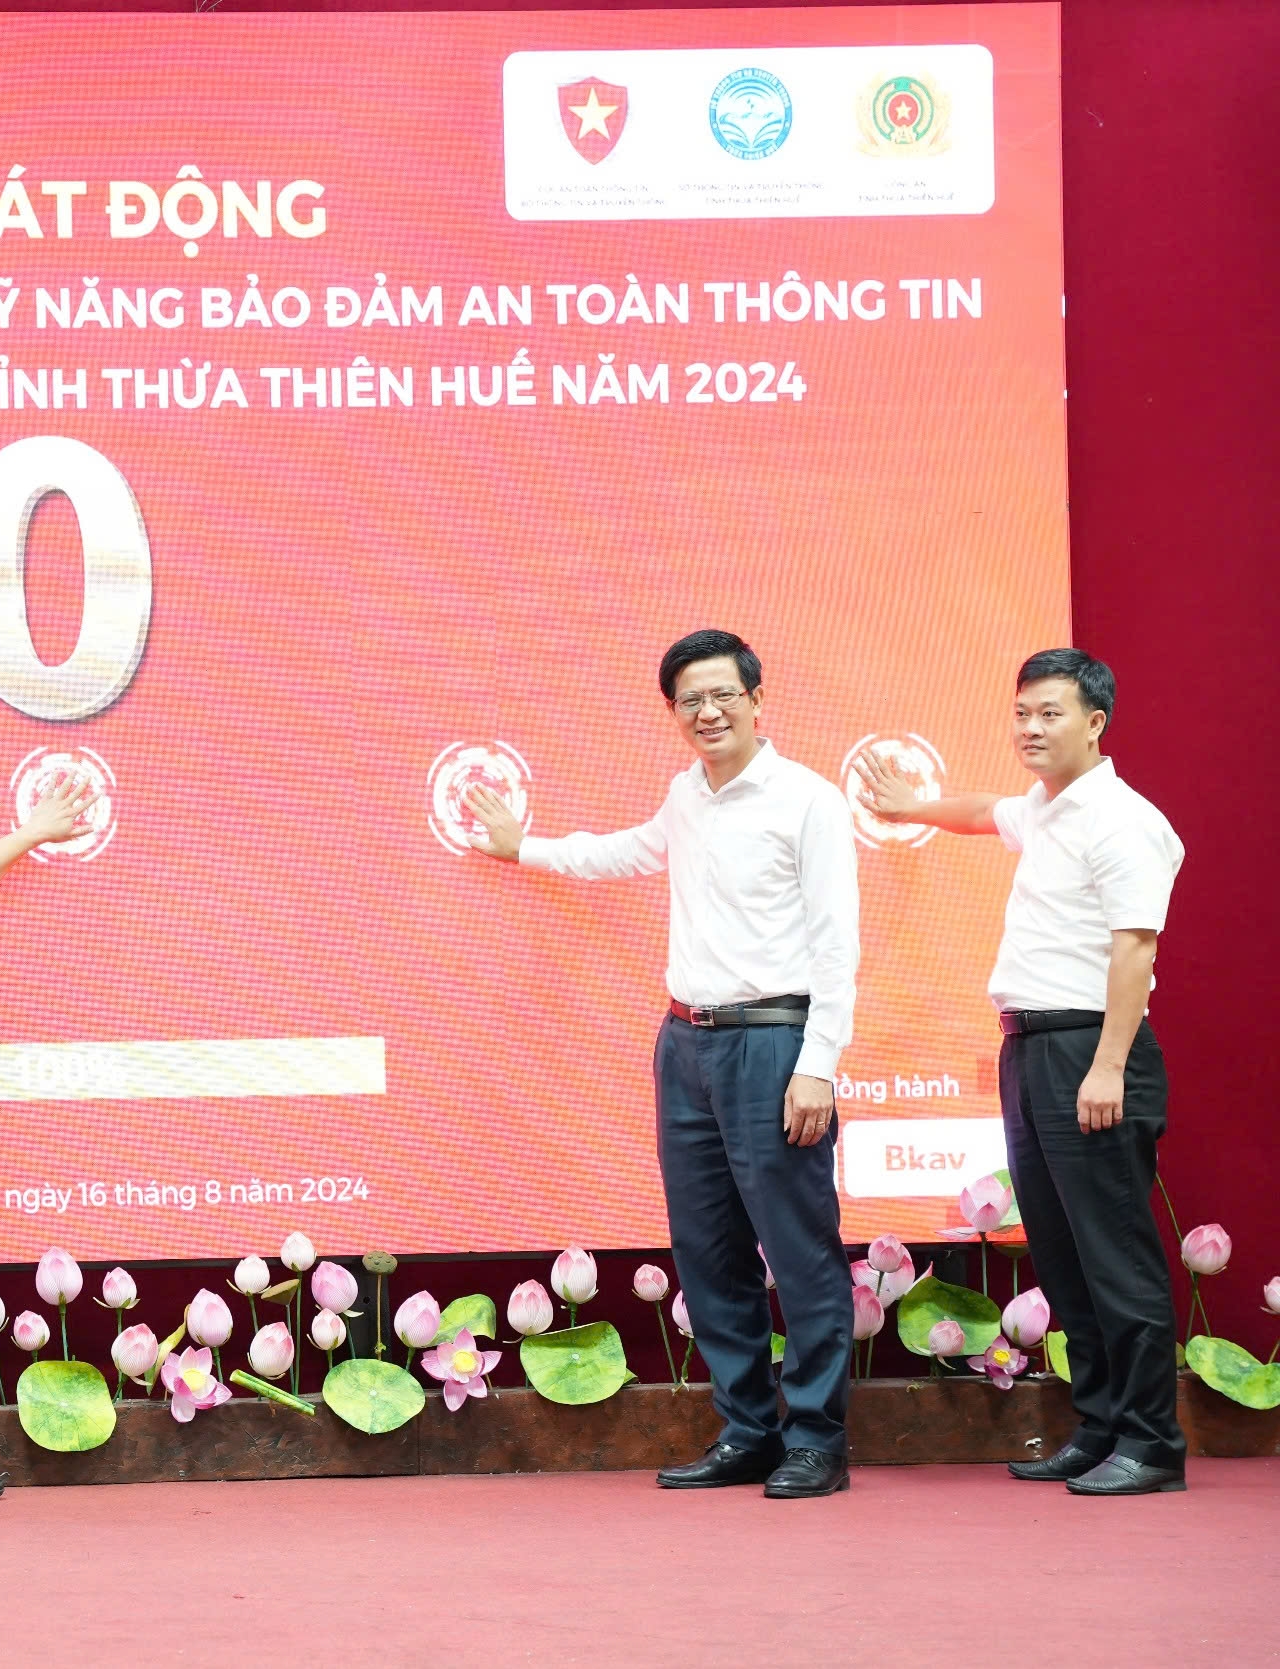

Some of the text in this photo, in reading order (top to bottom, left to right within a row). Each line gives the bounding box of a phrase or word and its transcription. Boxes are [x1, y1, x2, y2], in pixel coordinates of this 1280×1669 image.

[105, 164, 327, 258] ĐỘNG
[35, 276, 185, 329] NĂNG
[201, 273, 311, 329] BẢO
[323, 272, 443, 328] ĐẢM
[458, 284, 532, 327] AN
[546, 272, 690, 325] TOÀN
[703, 270, 886, 323] THÔNG
[898, 277, 982, 320] TIN
[101, 357, 249, 409] THỪA
[259, 355, 414, 408] THIÊN
[430, 349, 537, 407] HUẾ
[552, 352, 670, 405] NĂM
[684, 361, 808, 404] 2024
[895, 1073, 960, 1098] hành
[884, 1145, 966, 1171] Bkav
[4, 1182, 71, 1214] ngày
[77, 1182, 107, 1207] 16
[114, 1178, 197, 1212] tháng
[203, 1179, 223, 1205] 8
[229, 1177, 294, 1205] năm
[299, 1175, 371, 1203] 2024
